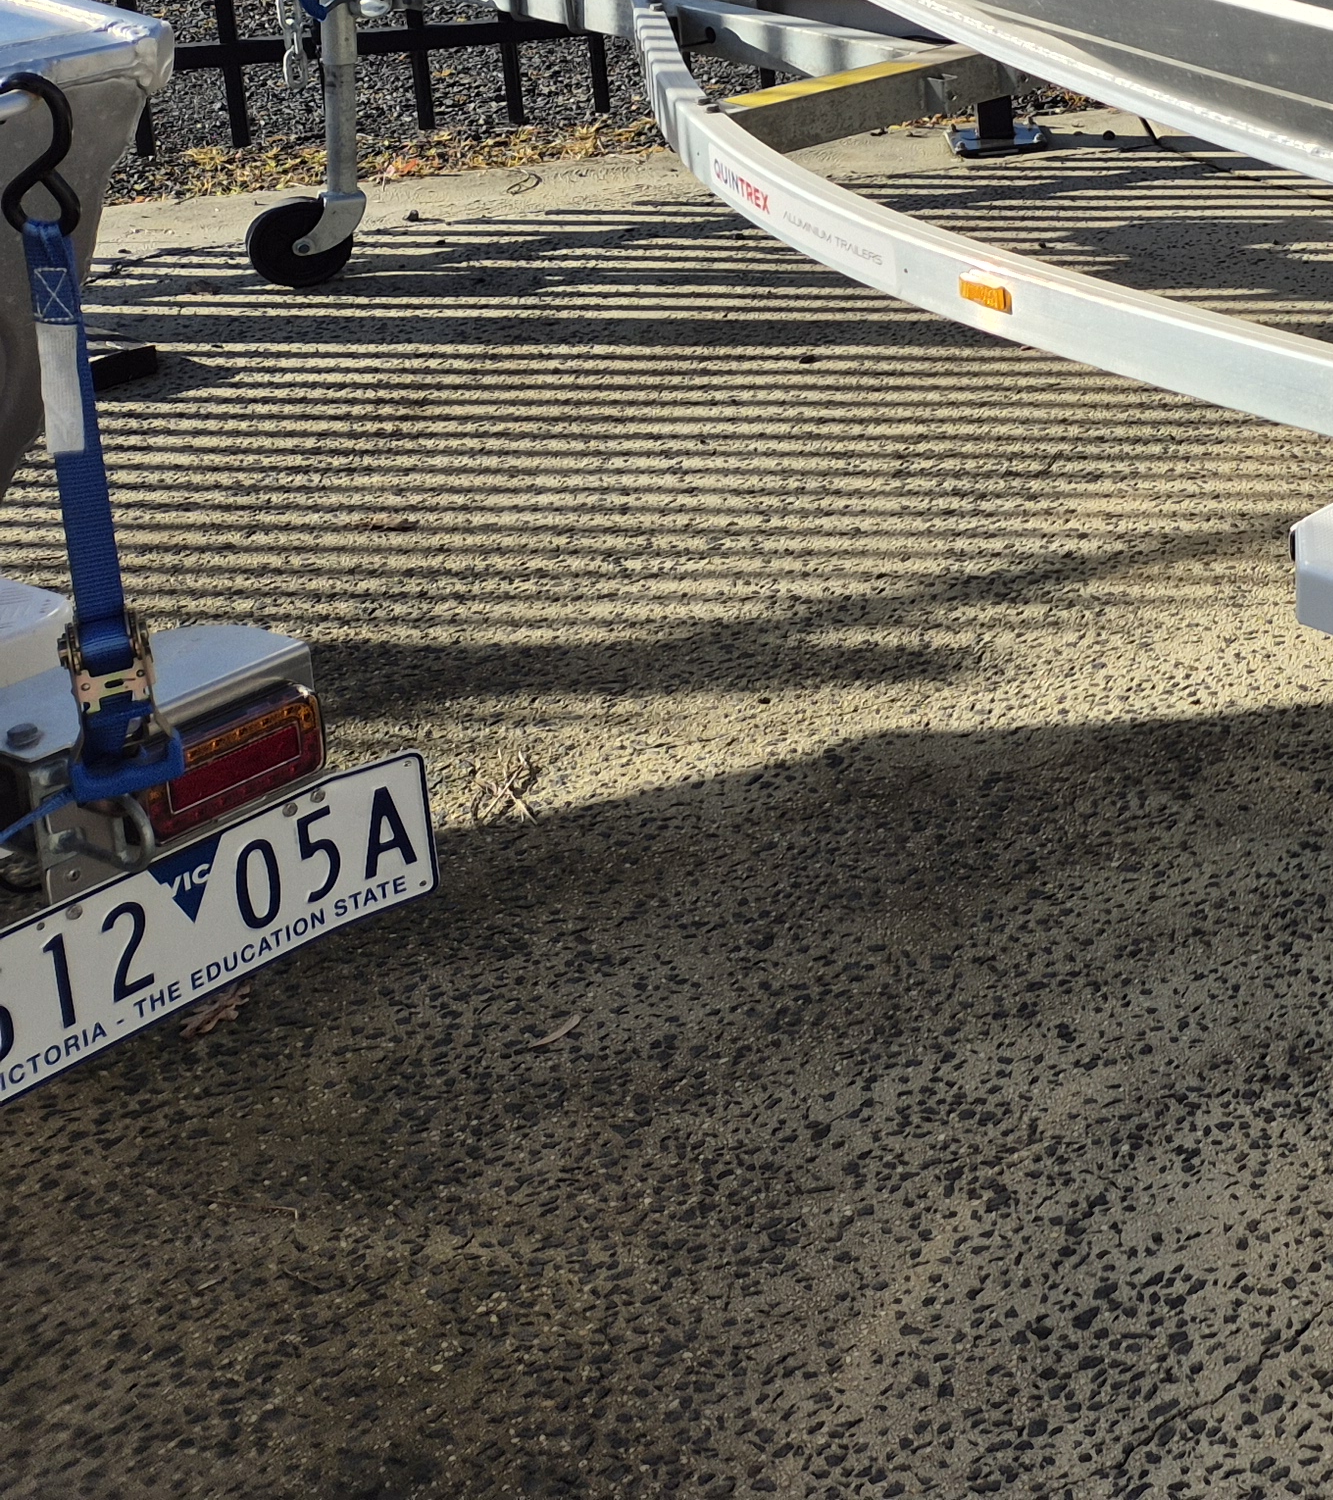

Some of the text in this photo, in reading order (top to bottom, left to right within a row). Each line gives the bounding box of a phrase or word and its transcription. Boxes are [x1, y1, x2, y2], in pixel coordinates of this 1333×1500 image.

[713, 158, 770, 214] QUINTREX
[161, 863, 210, 897] VIC
[235, 786, 418, 929] 05A
[0, 1021, 107, 1091] ICTORIA
[133, 980, 182, 1019] THE
[190, 907, 326, 991] EDUCATION
[333, 875, 408, 917] STATE
